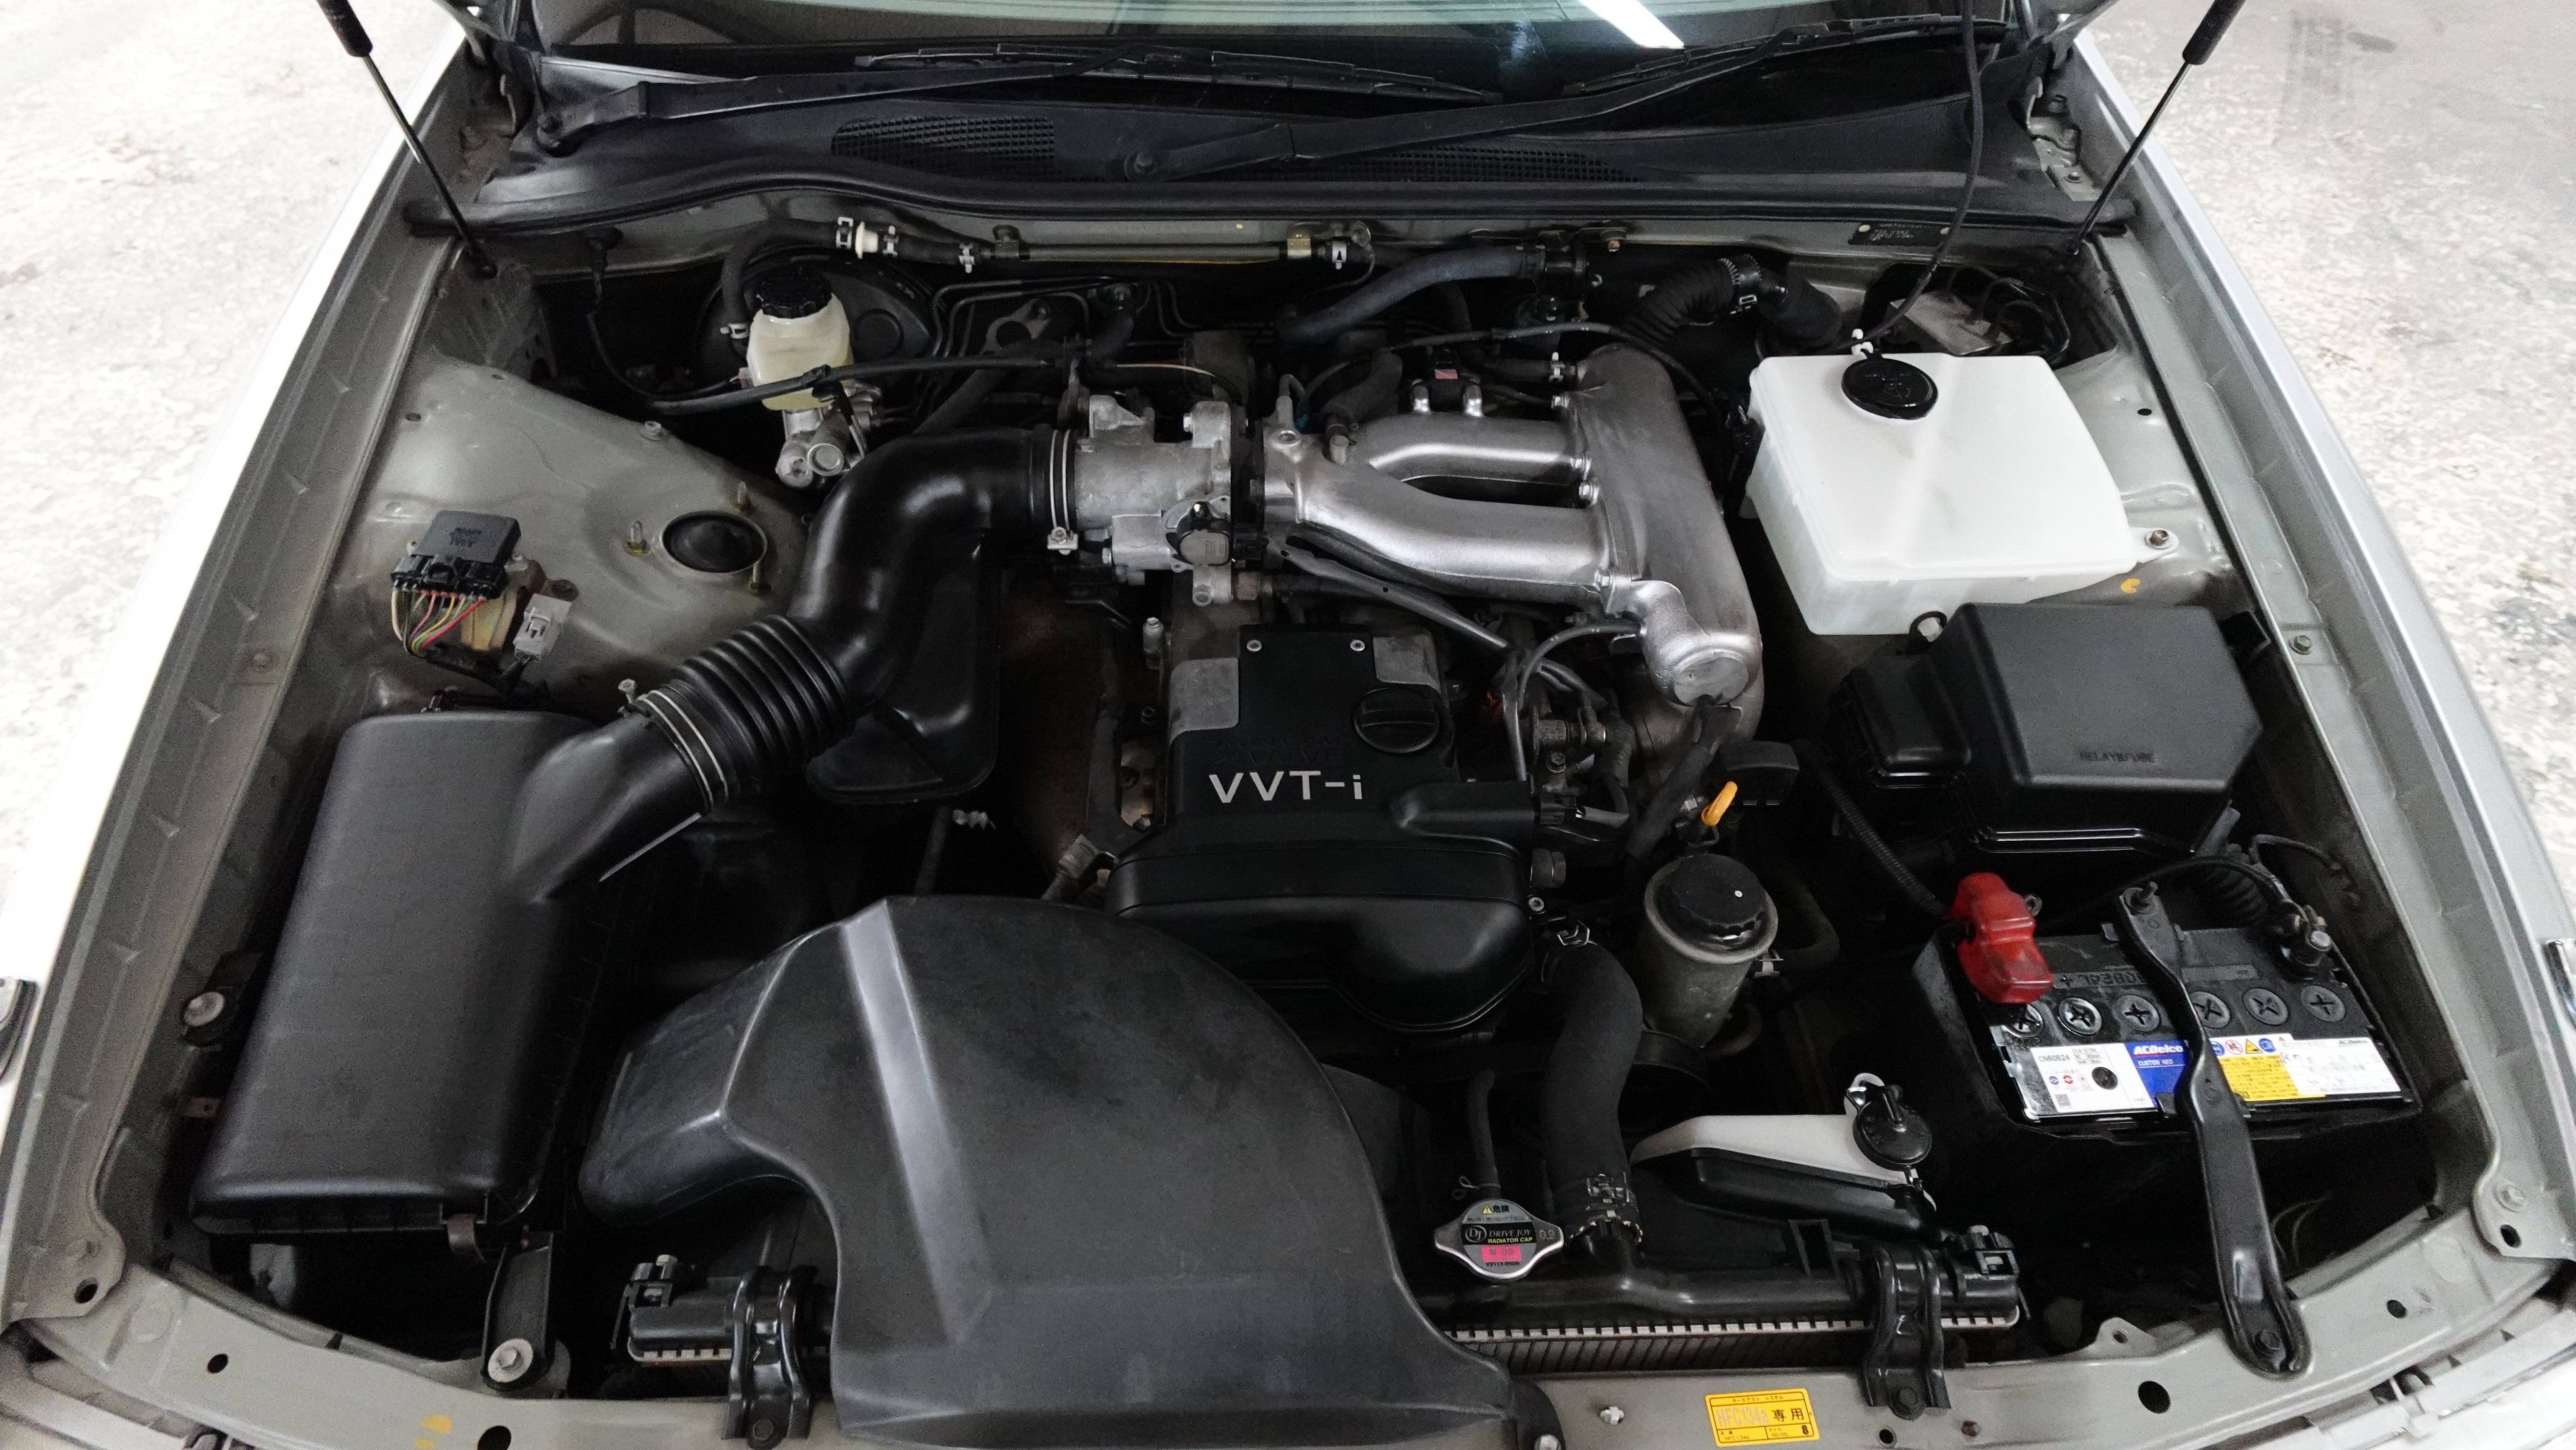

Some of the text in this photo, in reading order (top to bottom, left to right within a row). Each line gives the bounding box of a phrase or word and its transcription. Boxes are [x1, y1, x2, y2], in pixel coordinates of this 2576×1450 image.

[1208, 770, 1363, 804] VVT-i
[2133, 1045, 2184, 1055] ACDelco
[2038, 1054, 2070, 1062] CN60B24
[1489, 1229, 1514, 1237] DRIVE
[1716, 1406, 1769, 1426] HFC134a
[1801, 1425, 1809, 1435] 8
